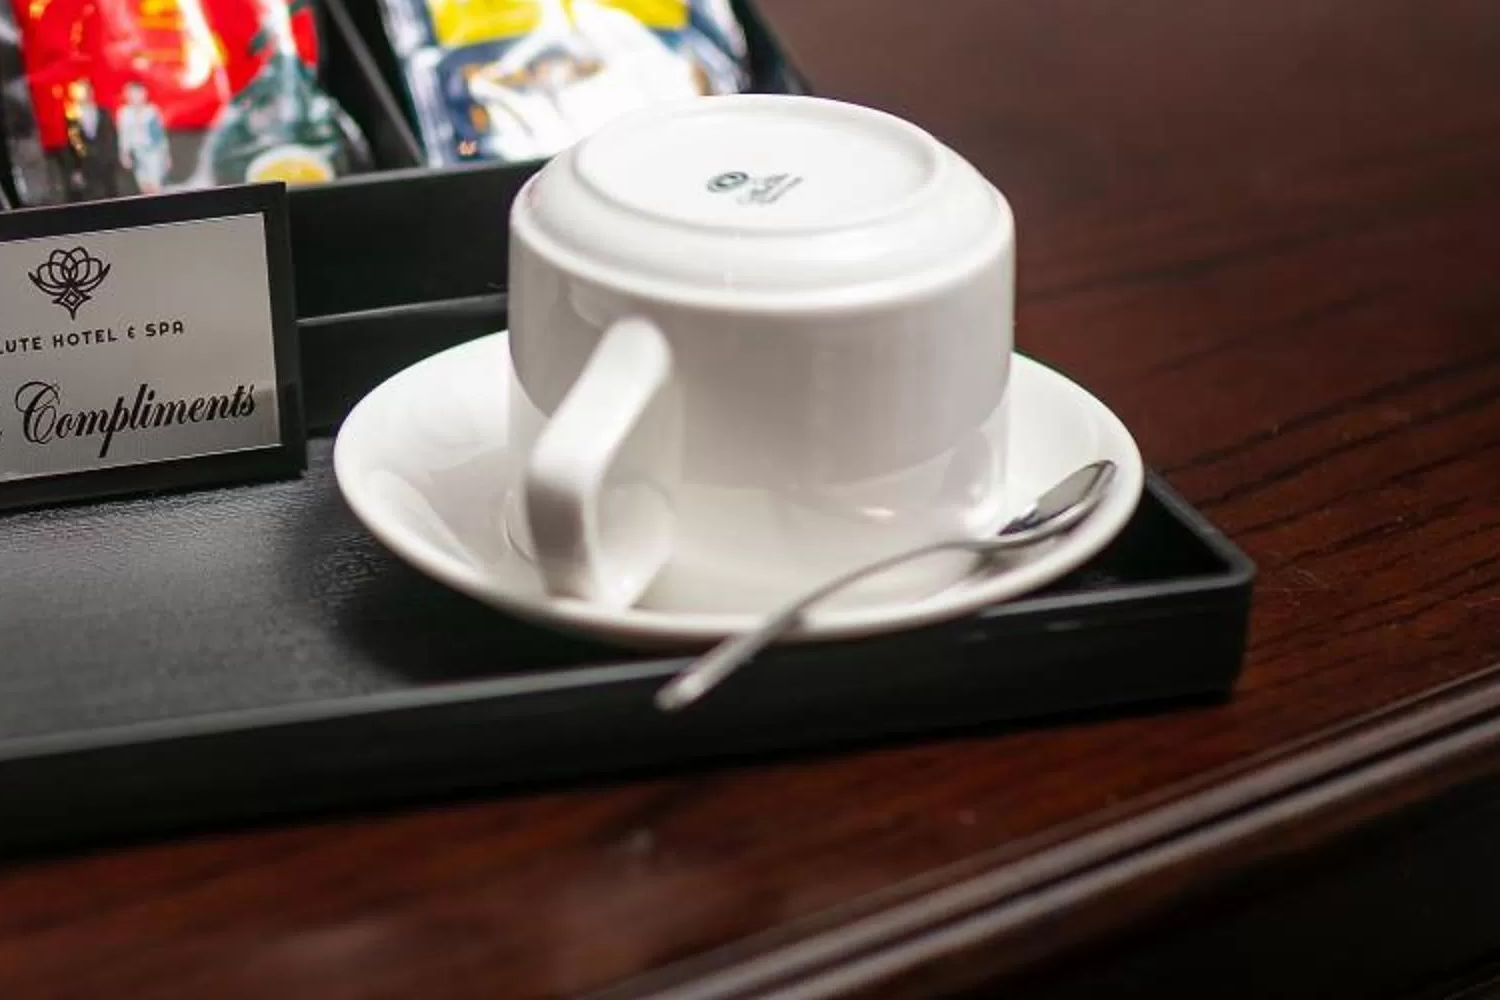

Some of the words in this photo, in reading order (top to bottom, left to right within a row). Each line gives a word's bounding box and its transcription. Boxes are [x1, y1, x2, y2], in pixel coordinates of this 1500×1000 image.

[53, 329, 117, 348] HOTEL
[145, 320, 184, 337] SPA
[15, 381, 256, 458] Compliments
